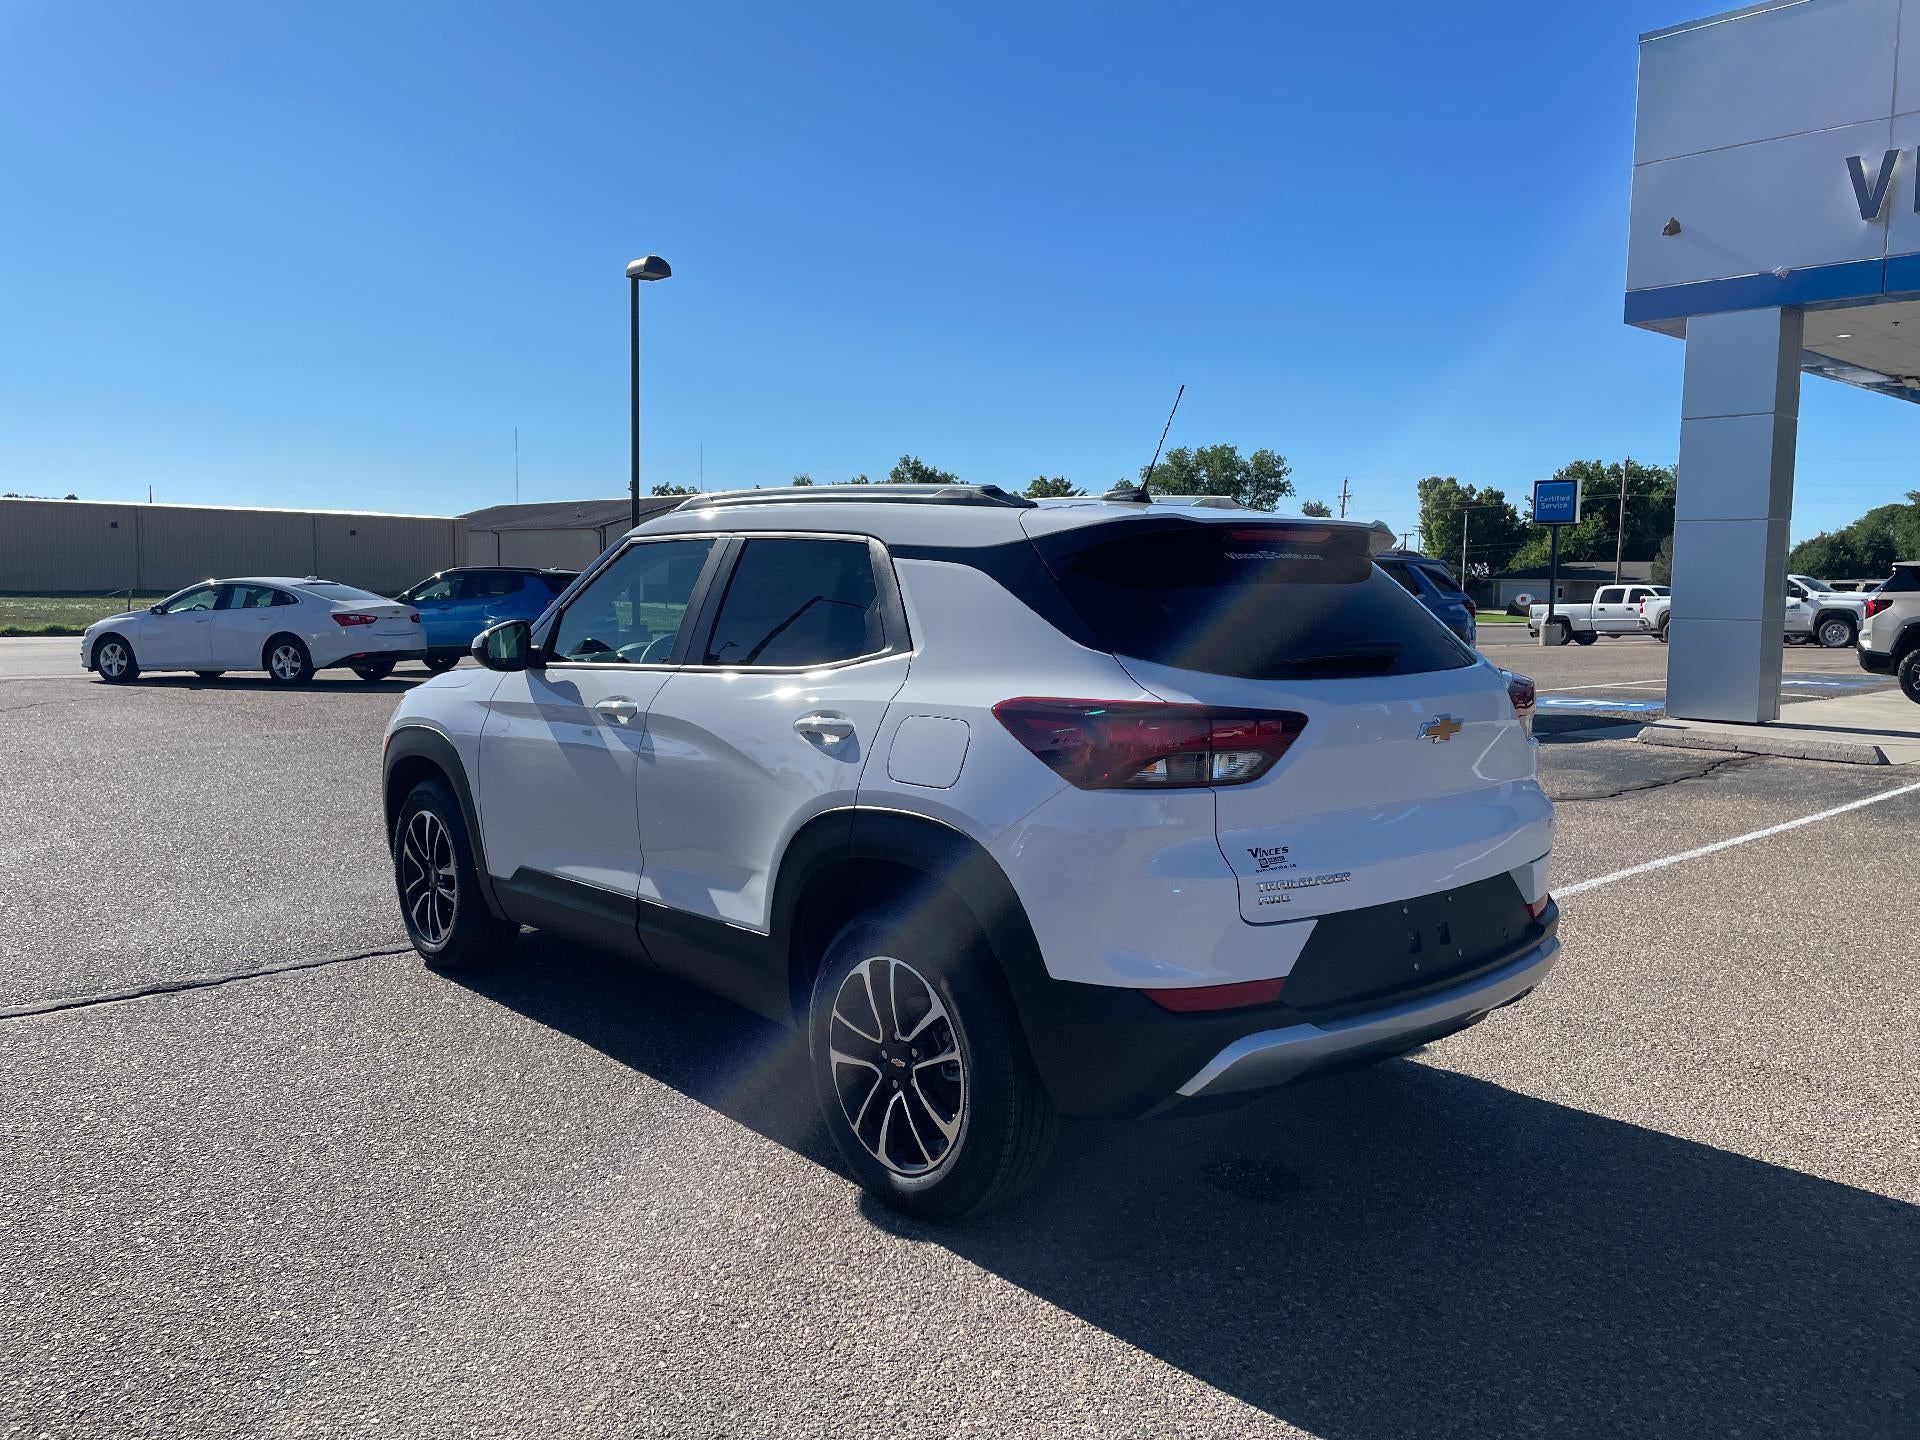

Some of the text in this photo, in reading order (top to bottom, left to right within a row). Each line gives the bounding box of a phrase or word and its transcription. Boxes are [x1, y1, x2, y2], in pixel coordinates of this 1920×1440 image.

[1540, 502, 1568, 510] Service
[1247, 846, 1289, 858] VINCE'S
[1256, 872, 1352, 893] TRAILBLAZER
